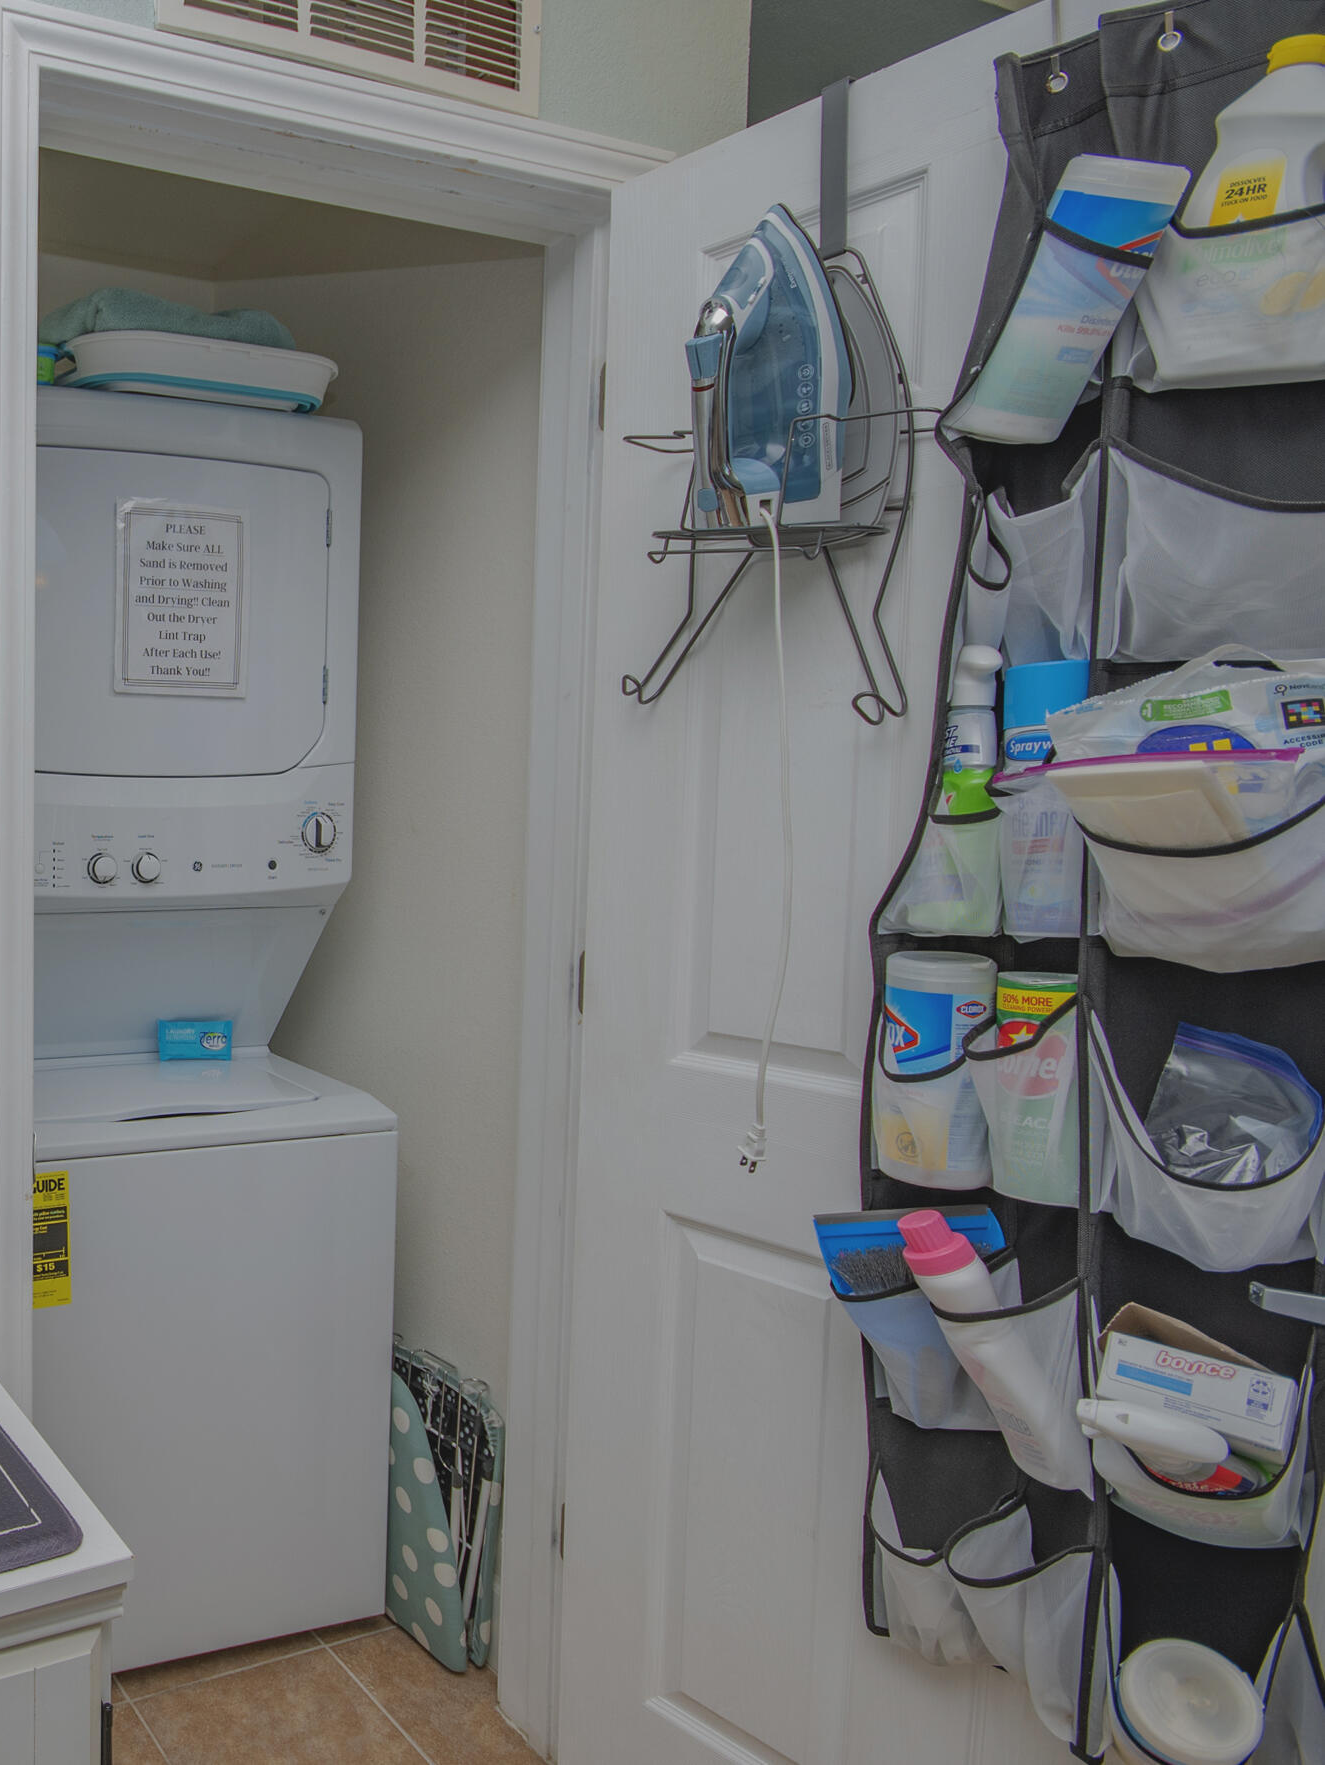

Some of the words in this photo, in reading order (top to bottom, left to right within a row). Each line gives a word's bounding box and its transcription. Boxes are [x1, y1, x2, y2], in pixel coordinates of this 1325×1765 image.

[165, 523, 206, 535] PLEASE
[146, 540, 174, 551] Make
[176, 542, 201, 553] Sure
[203, 544, 223, 554] ALL
[139, 558, 166, 569] Sand
[168, 559, 177, 569] is
[179, 560, 228, 572] Removed
[139, 576, 167, 587] Prior
[169, 577, 179, 587] to
[182, 578, 227, 592] Washing
[135, 594, 155, 605] and
[157, 595, 199, 608] Drying!!
[201, 597, 230, 608] Clean
[147, 612, 165, 622] Out
[168, 612, 185, 623] the
[188, 614, 218, 625] Dryer
[158, 630, 179, 641] Lint
[181, 631, 206, 644] Trap
[143, 647, 170, 658] After
[172, 648, 197, 659] Each
[200, 650, 221, 660] Use!
[150, 665, 182, 676] Thank
[185, 666, 211, 677] You!!
[1022, 996, 1053, 1007] MORE
[1156, 1349, 1237, 1380] bounce
